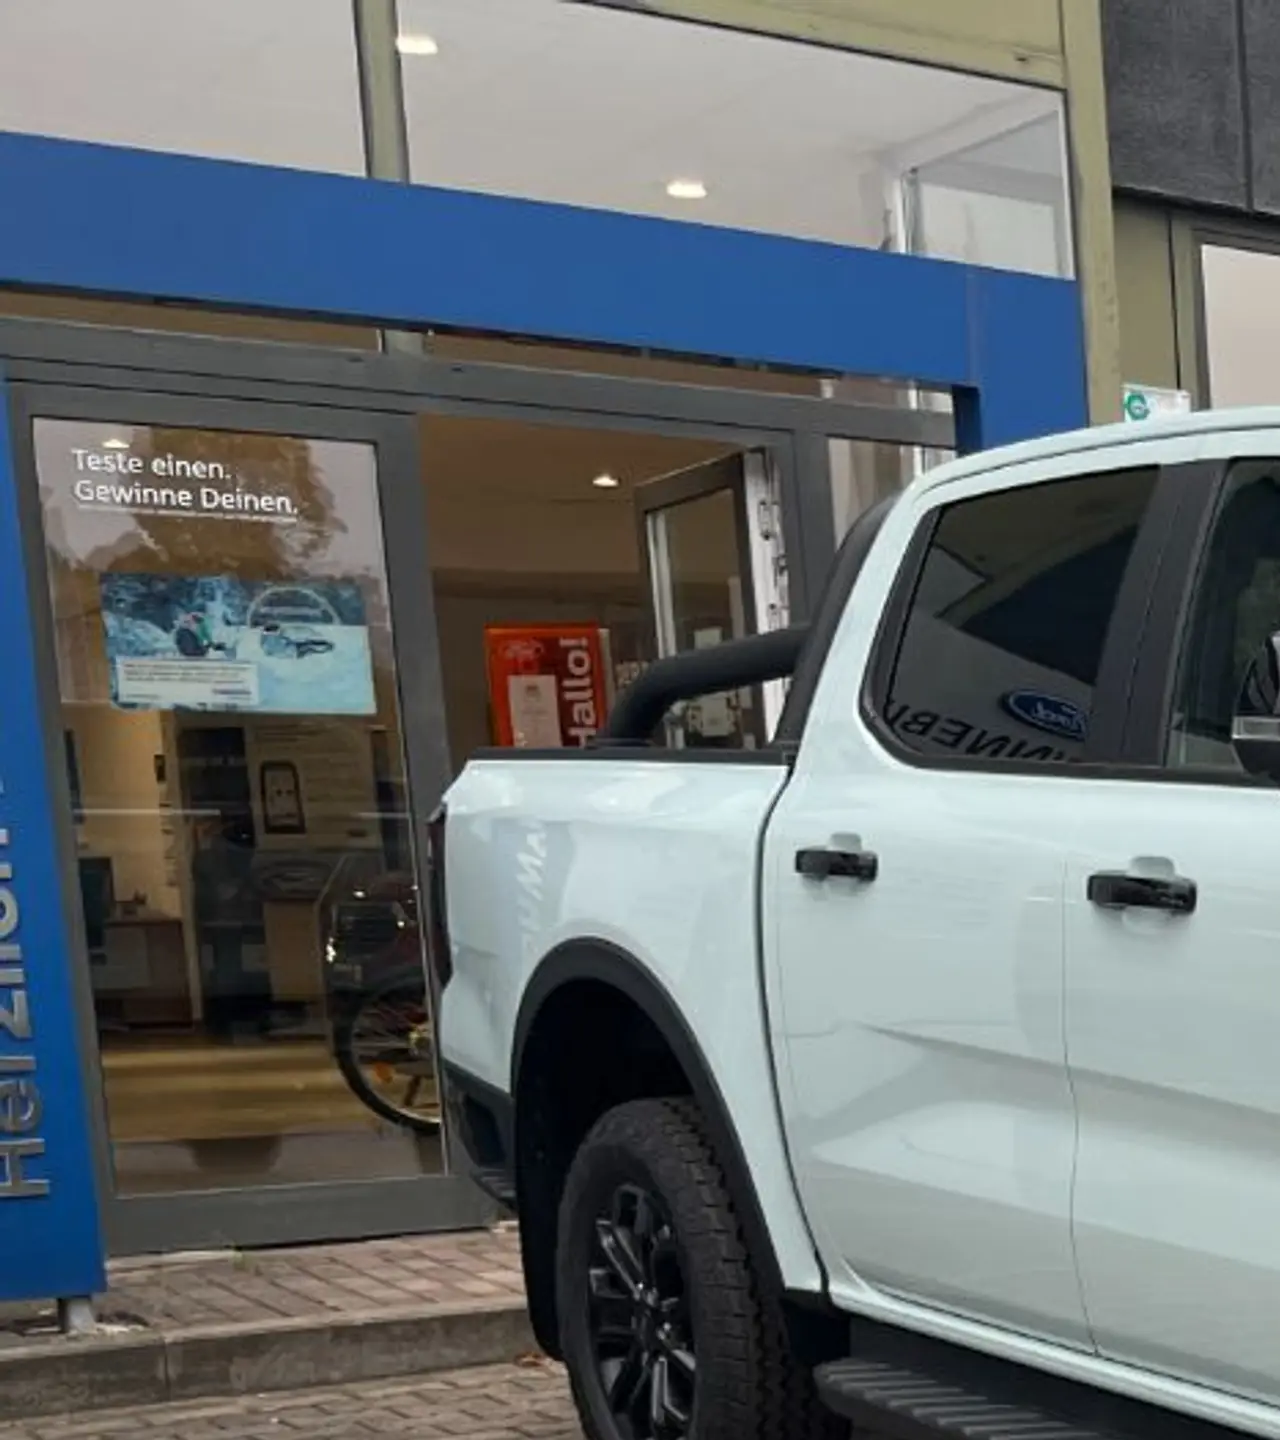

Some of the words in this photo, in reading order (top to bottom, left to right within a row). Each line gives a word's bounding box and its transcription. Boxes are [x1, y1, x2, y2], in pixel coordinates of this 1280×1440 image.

[72, 449, 143, 474] Teste
[151, 453, 232, 480] einen.
[74, 480, 193, 507] Gewinne
[201, 487, 298, 514] Deinen.
